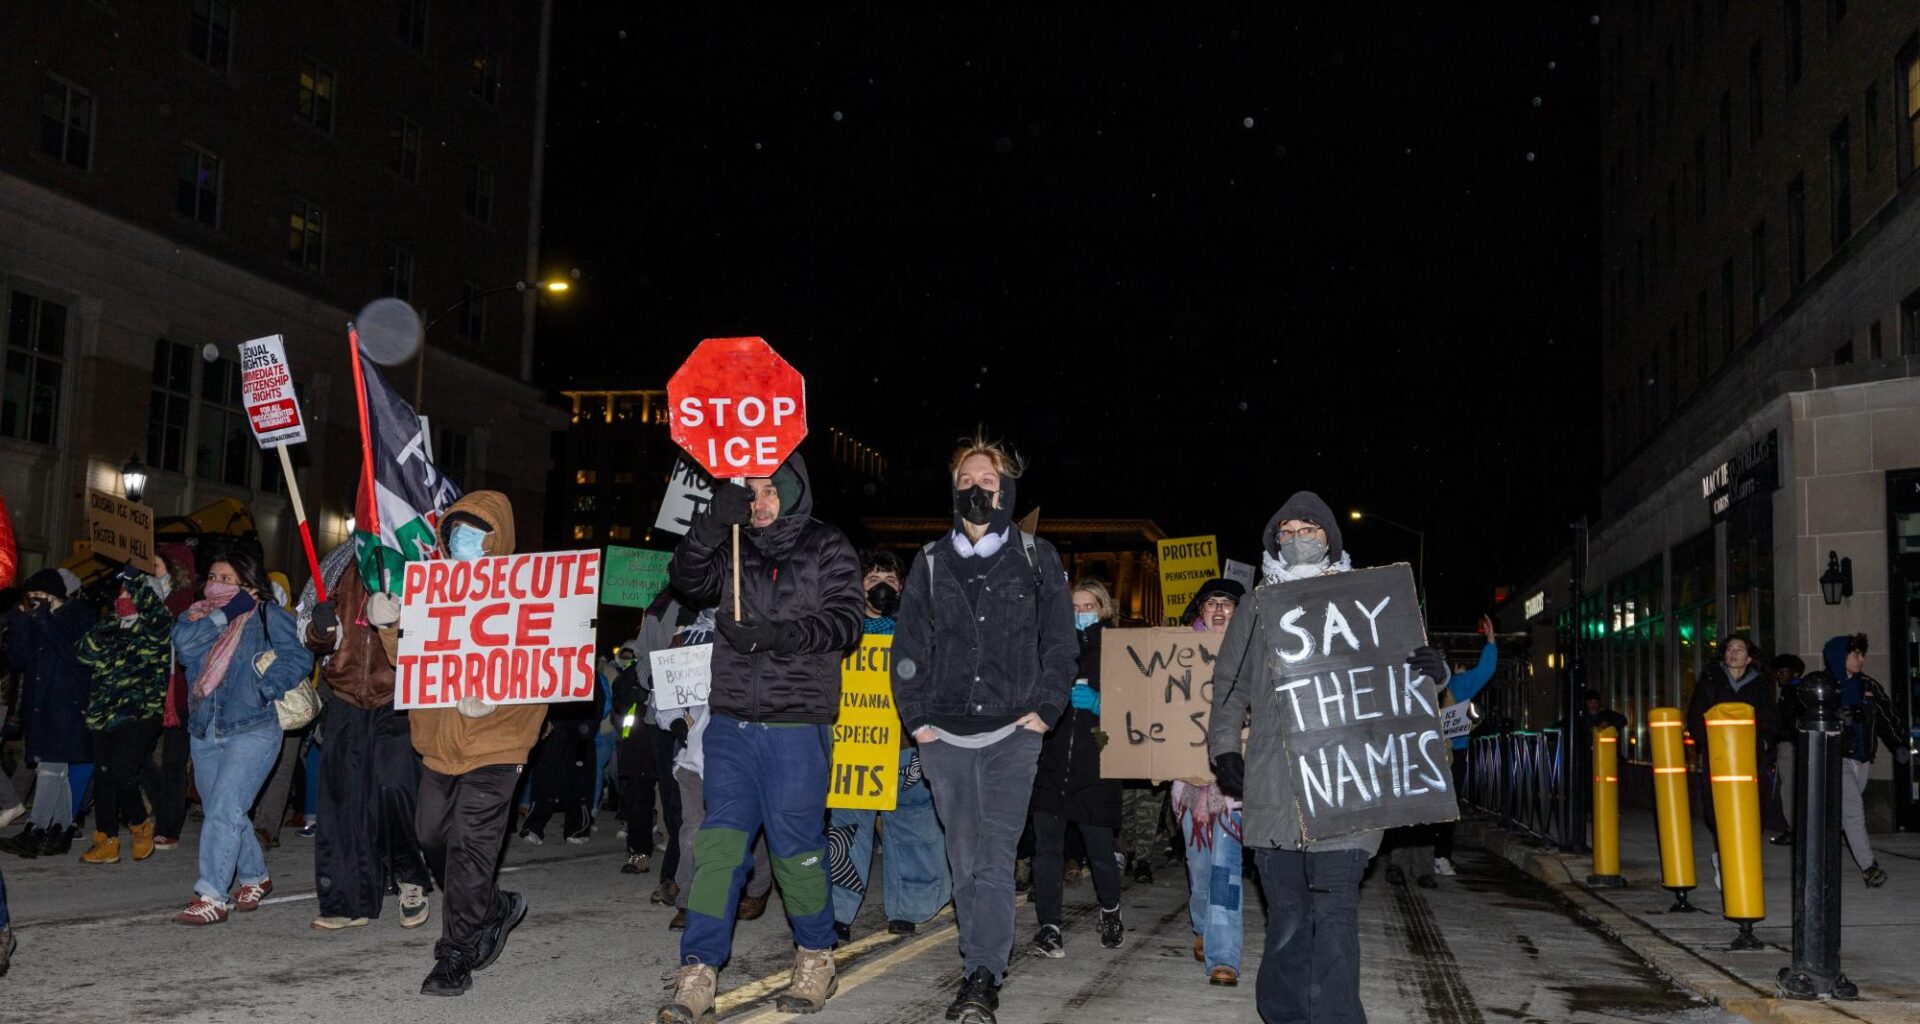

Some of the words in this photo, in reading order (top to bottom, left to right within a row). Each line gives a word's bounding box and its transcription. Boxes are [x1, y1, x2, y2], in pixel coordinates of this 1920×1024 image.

[244, 344, 270, 359] EQUAL
[270, 354, 278, 364] &
[243, 364, 284, 383] IMMEDIATE
[243, 374, 289, 394] CITIZENSHIP
[252, 387, 282, 403] RIGHTS
[260, 405, 271, 416] FOR
[271, 404, 282, 414] ALL
[680, 396, 796, 427] STOP
[708, 436, 778, 468] ICE
[119, 534, 127, 550] IN
[1162, 541, 1212, 560] PROTECT
[404, 552, 598, 606] PROSECUTE
[1166, 568, 1216, 582] PENNSYLVANIA
[1167, 592, 1186, 605] FREE
[424, 602, 554, 652] ICE
[1276, 596, 1390, 663] SAY
[657, 654, 676, 664] THE
[398, 644, 594, 704] TERRORISTS
[1276, 662, 1436, 732] THEIR
[834, 724, 889, 744] SPEECH
[1126, 711, 1166, 745] be
[1300, 730, 1447, 817] NAMES
